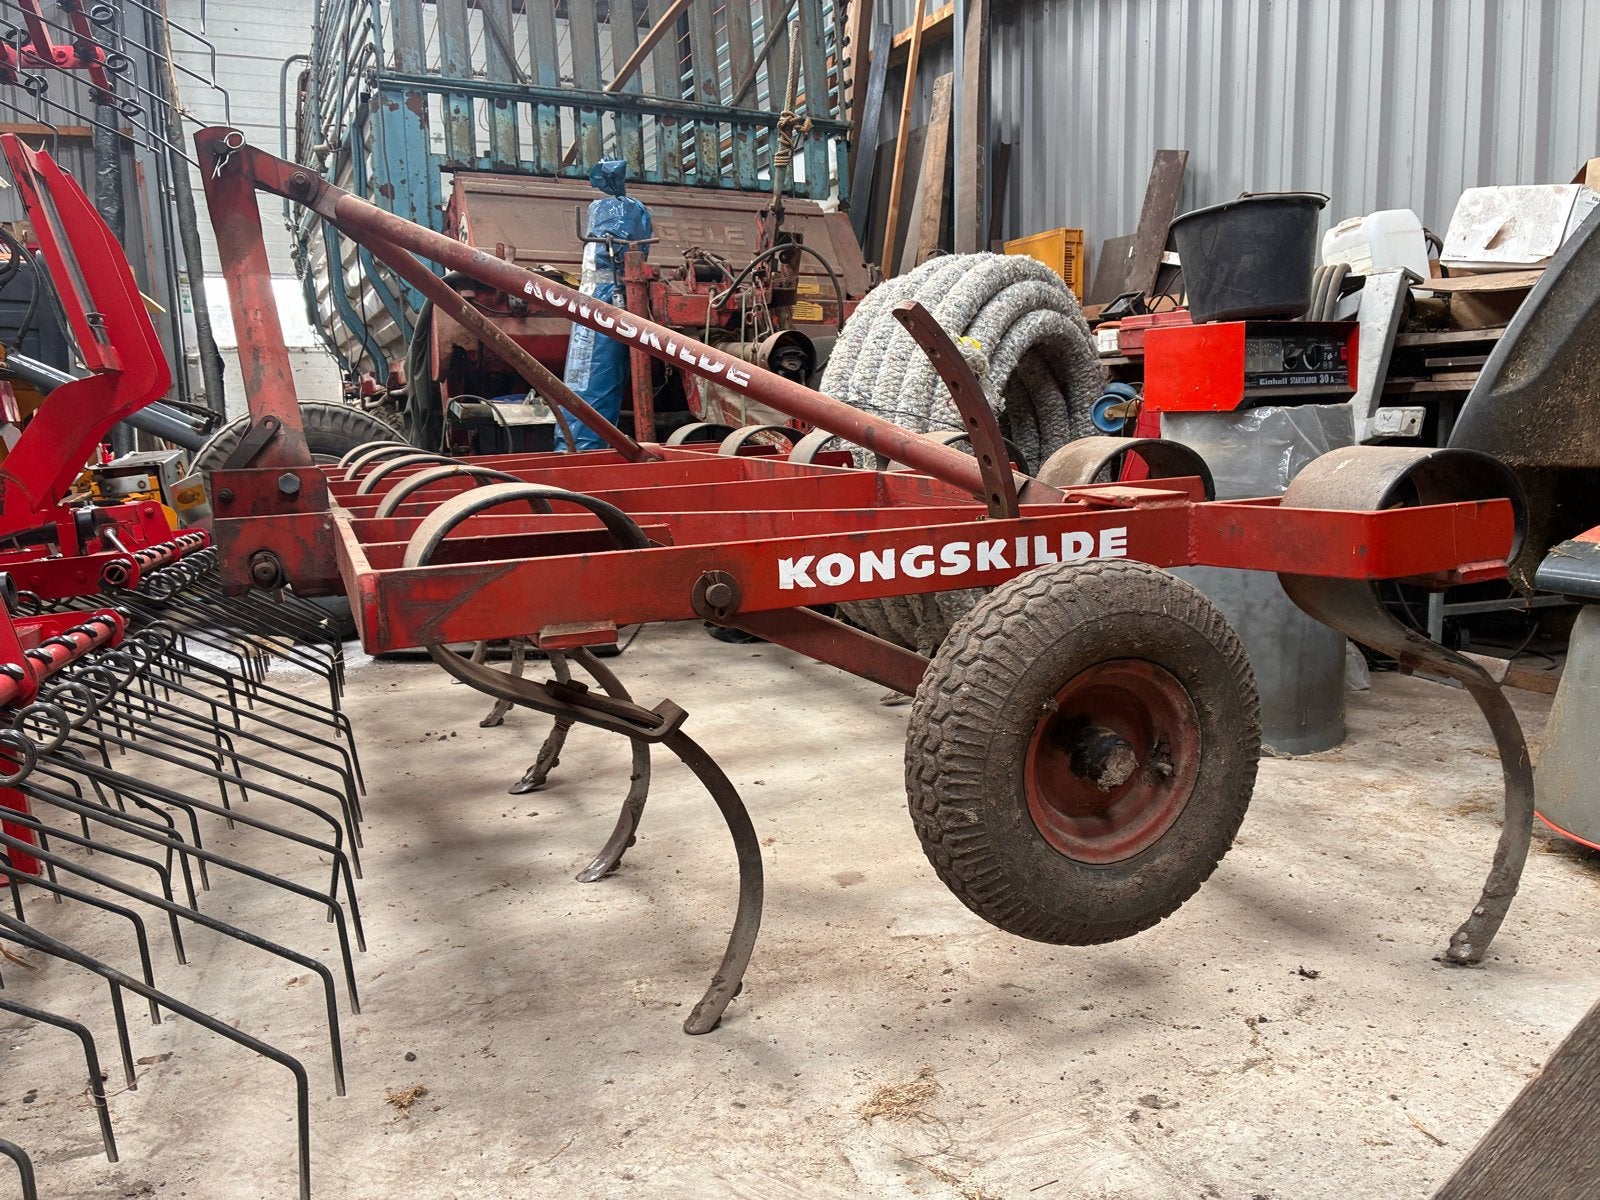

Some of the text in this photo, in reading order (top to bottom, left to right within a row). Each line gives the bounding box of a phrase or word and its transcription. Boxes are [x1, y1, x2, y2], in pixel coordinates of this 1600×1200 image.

[1259, 377, 1288, 386] Einhell
[1319, 373, 1330, 384] 30
[778, 526, 1128, 590] KONGSKILDE
